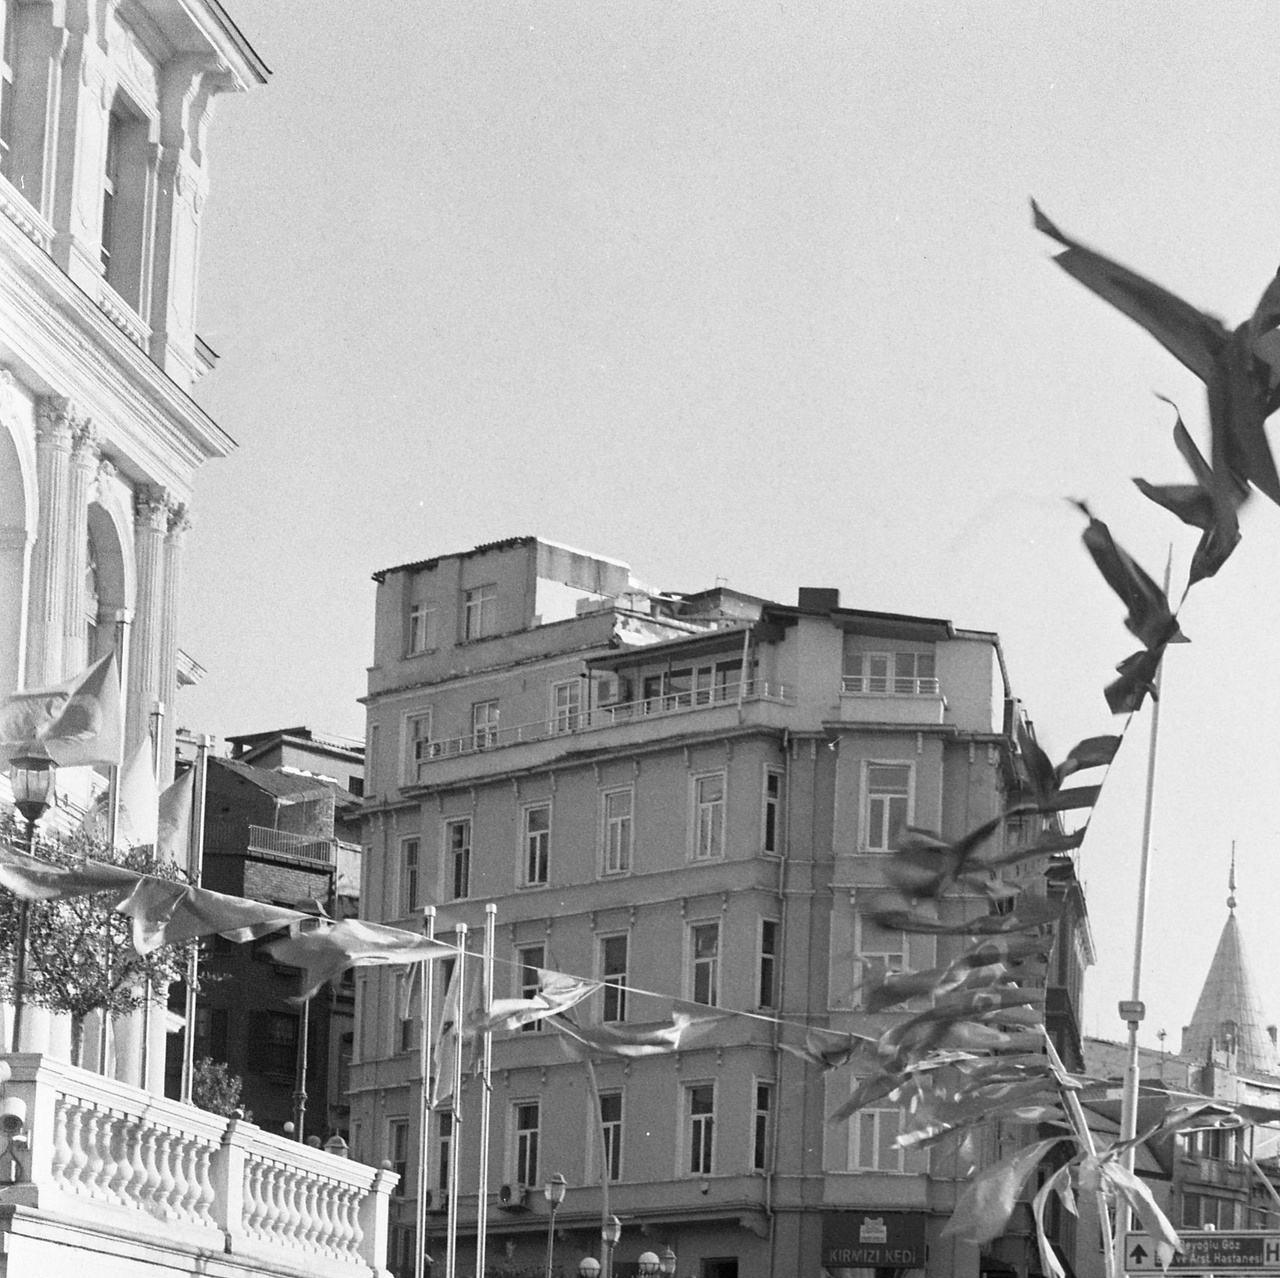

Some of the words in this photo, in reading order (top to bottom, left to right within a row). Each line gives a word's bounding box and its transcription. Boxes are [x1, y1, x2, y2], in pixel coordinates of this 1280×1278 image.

[1222, 1239, 1241, 1250] Göz
[829, 1249, 880, 1263] KIRMIZI
[1214, 1253, 1263, 1264] Hastanesi
